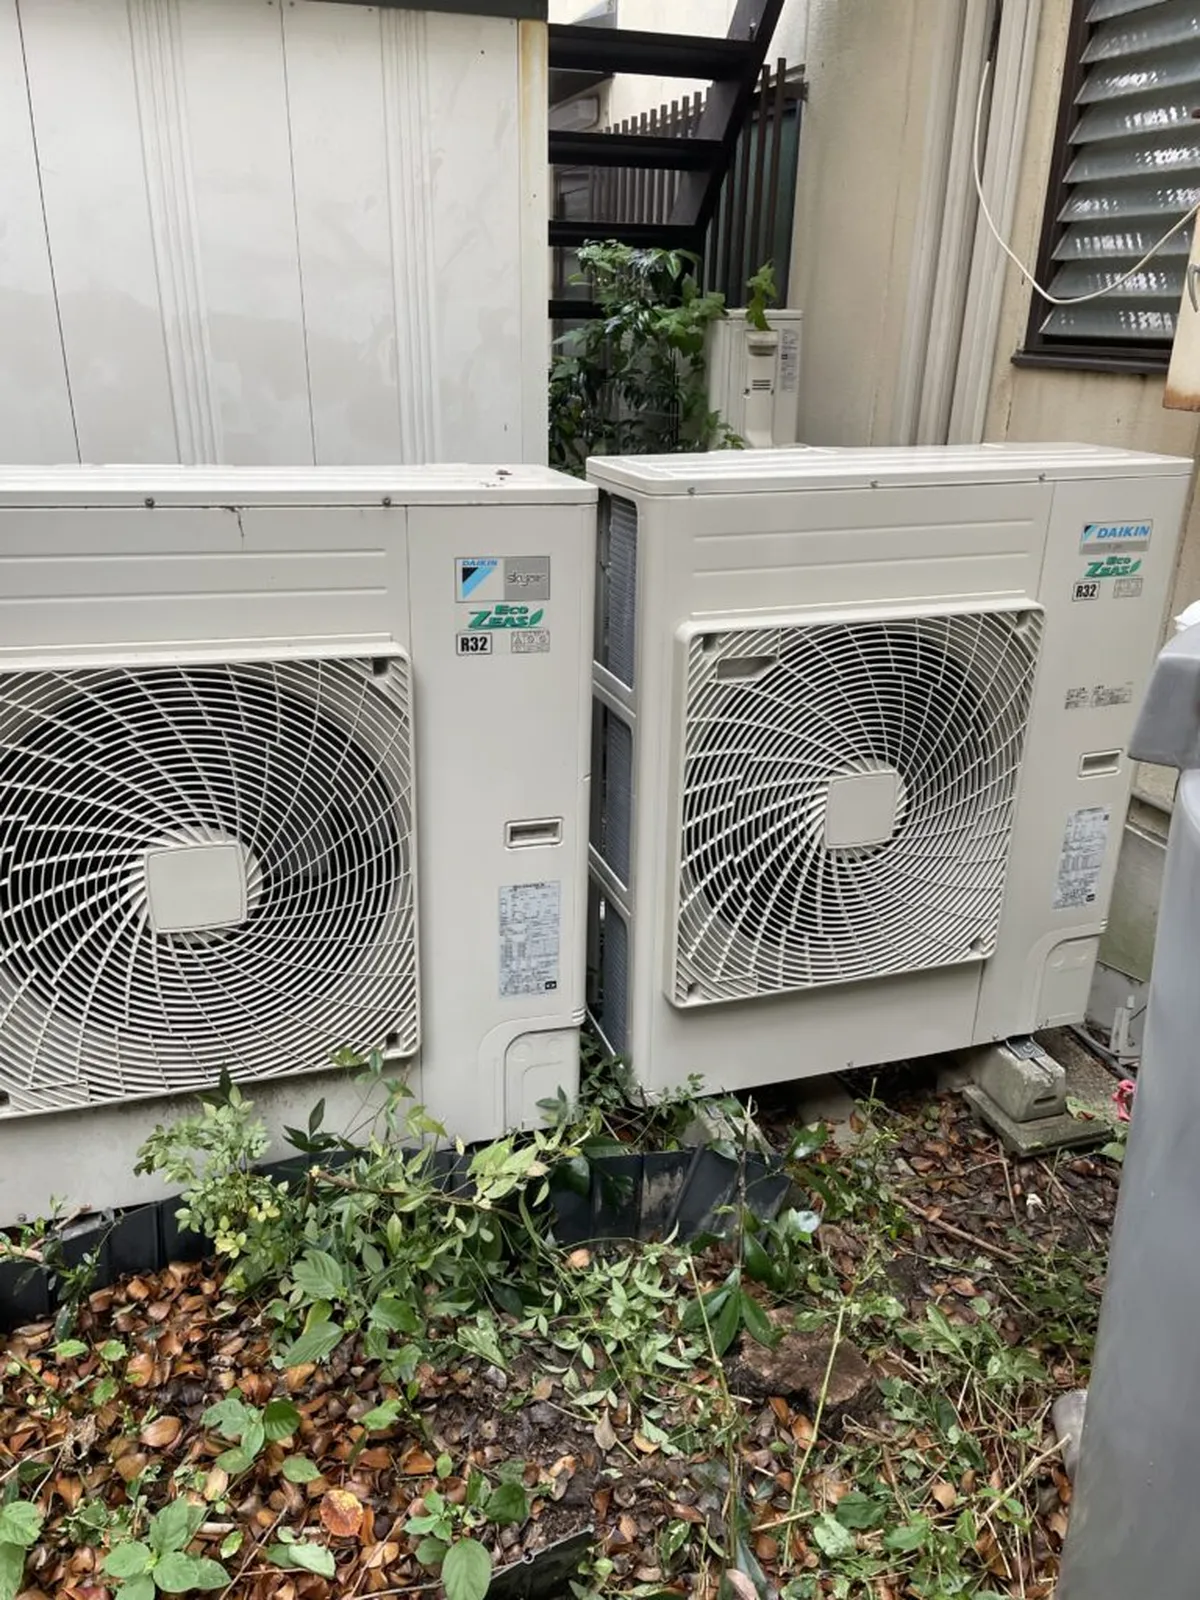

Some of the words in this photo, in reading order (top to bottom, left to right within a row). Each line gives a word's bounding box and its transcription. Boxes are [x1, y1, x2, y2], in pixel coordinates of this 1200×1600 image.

[1096, 526, 1150, 539] DAIKIN
[1076, 584, 1097, 598] R32
[468, 610, 529, 630] ZEAS
[460, 636, 488, 652] R32
